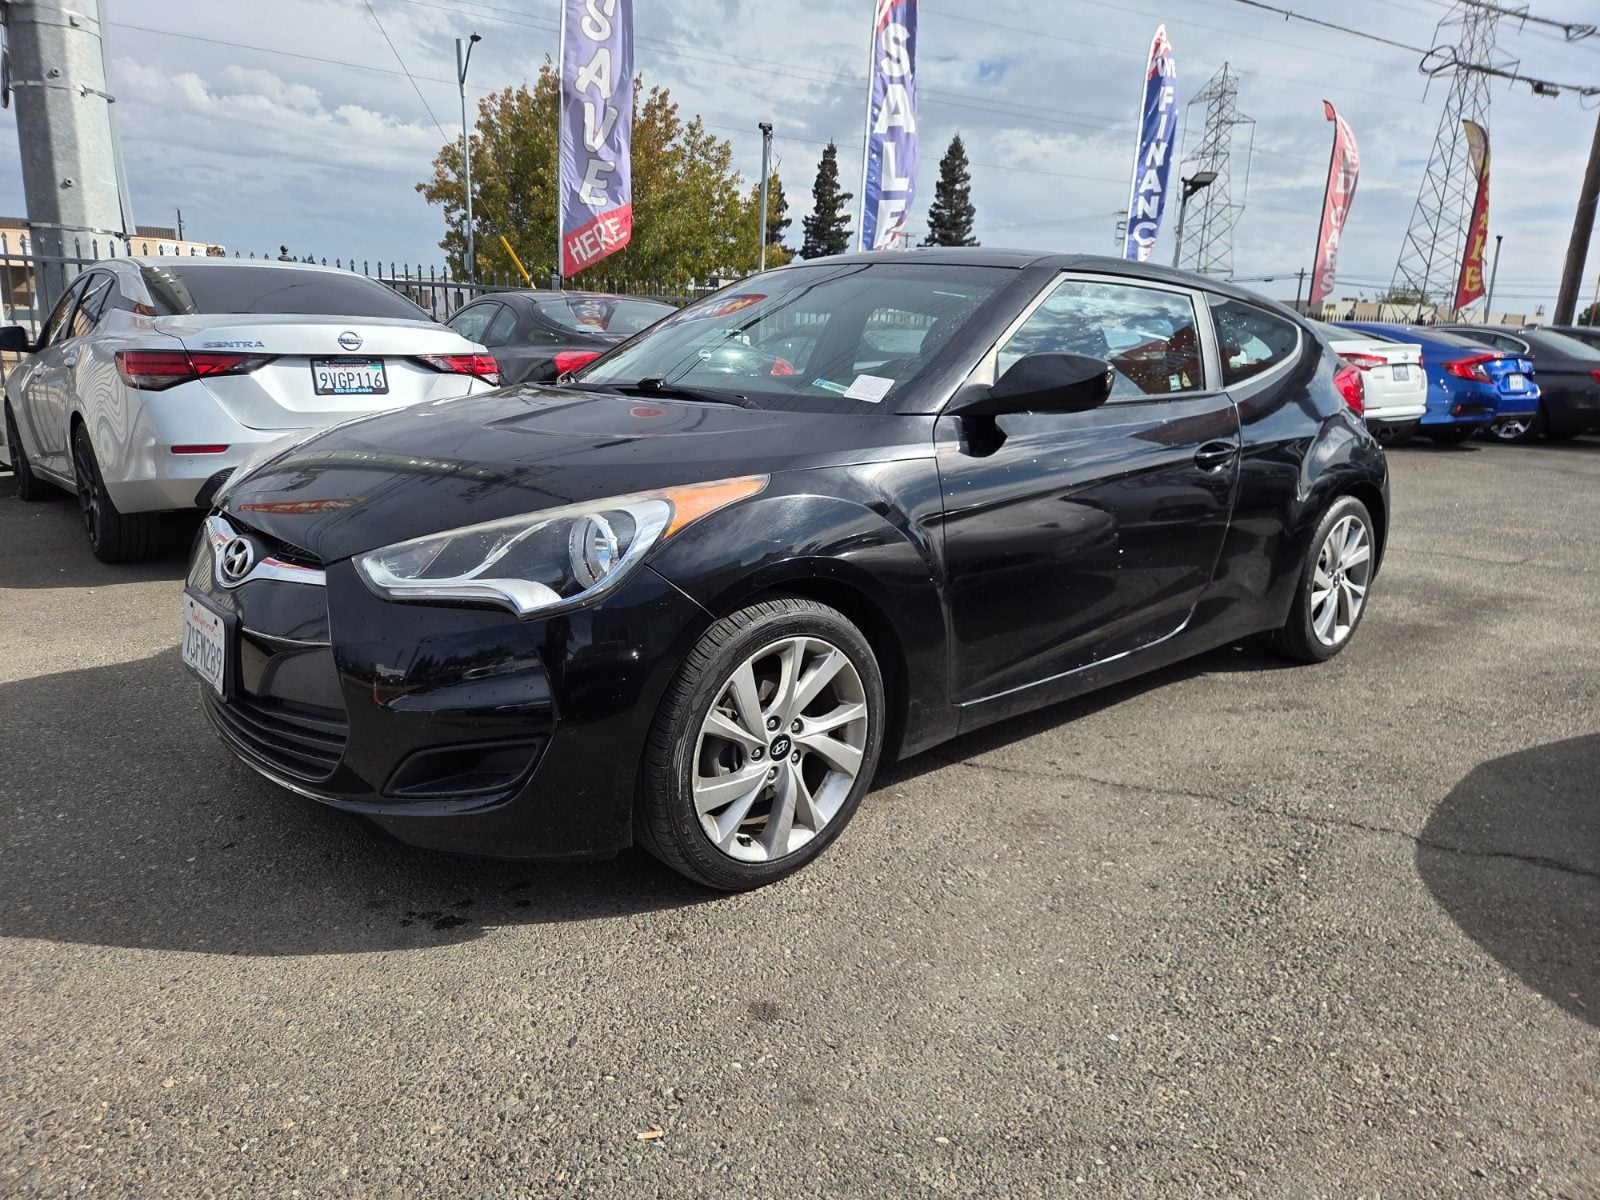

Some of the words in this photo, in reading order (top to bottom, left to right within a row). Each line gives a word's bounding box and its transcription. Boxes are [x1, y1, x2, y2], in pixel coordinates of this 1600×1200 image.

[575, 0, 618, 206] SAVE
[873, 22, 916, 249] SALE
[567, 216, 628, 265] HERE
[1320, 206, 1344, 292] CARS
[1464, 178, 1490, 292] ALE
[202, 341, 265, 349] SENTRA
[319, 372, 383, 389] 9VGP116
